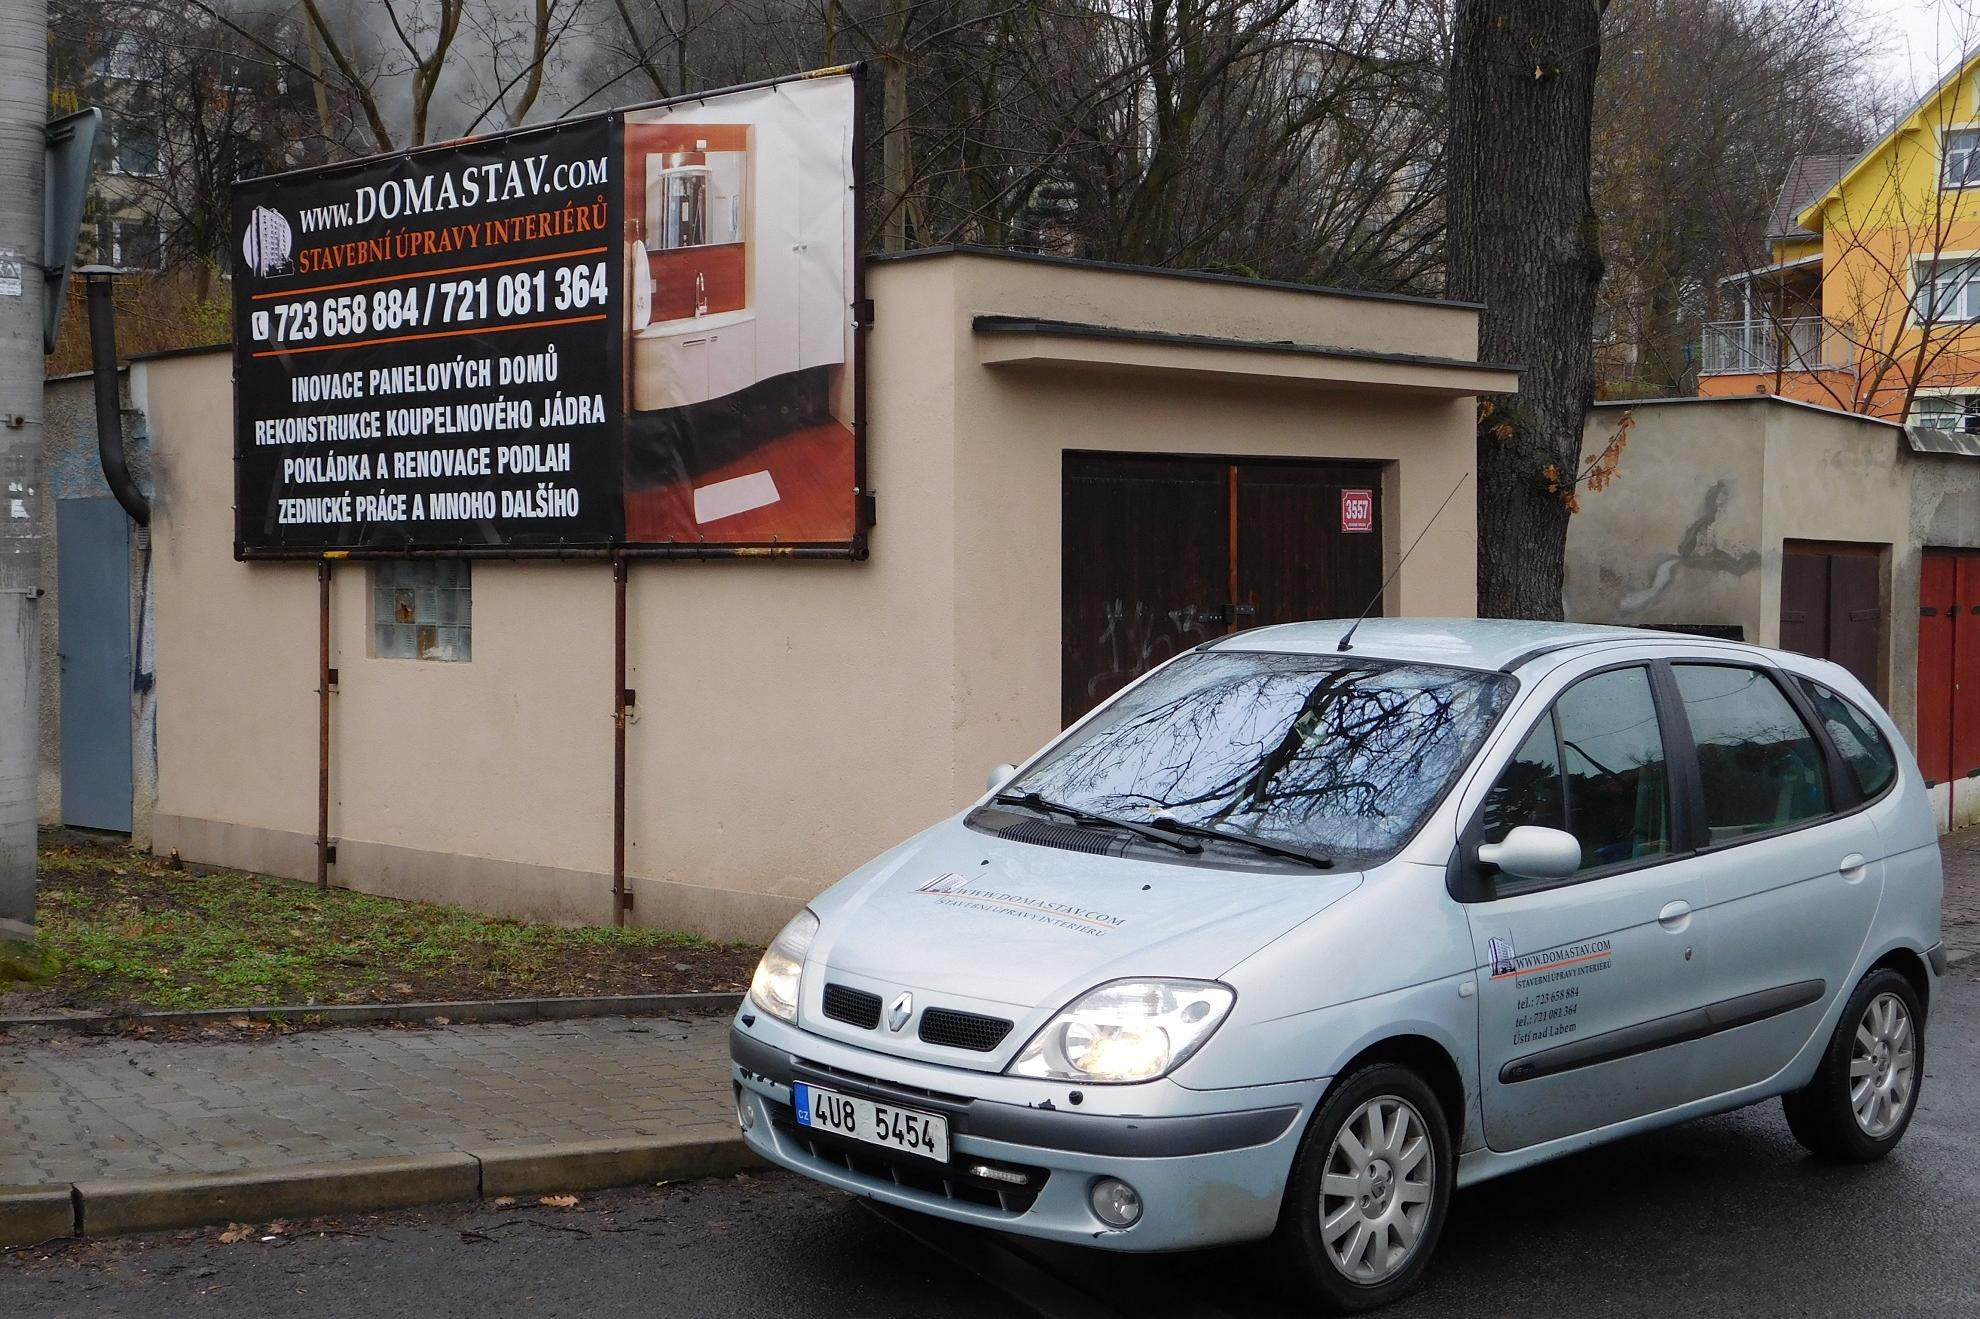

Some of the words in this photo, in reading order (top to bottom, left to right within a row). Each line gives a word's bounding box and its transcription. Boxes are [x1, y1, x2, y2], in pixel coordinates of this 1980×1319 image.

[300, 229, 392, 273] STAVEBNÍ
[396, 222, 481, 259] ÚPRAVY
[485, 195, 608, 247] INTERIÉRŮ
[274, 300, 318, 342] 723
[323, 294, 367, 336] 658
[373, 287, 419, 331] 884
[441, 278, 487, 322] 721
[497, 270, 545, 317] 081
[555, 262, 608, 311] 364
[292, 371, 363, 403] INOVACE
[370, 354, 491, 396] PANELOVÝCH
[500, 343, 558, 385] DOMŮ
[255, 411, 380, 446] REKONSTRUKCE
[387, 395, 532, 437] KOUPELNOVÉHO
[539, 391, 605, 428] JÁDRA
[284, 450, 371, 484] POKLÁDKA
[376, 456, 388, 480] A
[394, 447, 490, 478] RENOVACE
[498, 442, 570, 473] PODLAH
[278, 490, 352, 524] ZEDNICKÉ
[356, 488, 407, 522] PRÁCE
[412, 493, 424, 521] A
[430, 489, 495, 520] MNOHO
[502, 482, 578, 518] DALŠÍHO
[1346, 499, 1368, 519] 3557
[1516, 940, 1611, 970] WWW.DOMASTAV.COM
[1534, 1011, 1547, 1024] 721
[1549, 1007, 1562, 1020] 081
[1563, 1004, 1577, 1016] 364
[1536, 993, 1549, 1006] 723
[1551, 989, 1564, 1002] 658
[1565, 986, 1579, 999] 884
[1513, 1029, 1531, 1046] Ústí
[1532, 1026, 1549, 1041] nad
[1549, 1023, 1577, 1037] Labem
[798, 1109, 809, 1121] CZ
[815, 1094, 856, 1133] 4U8
[875, 1107, 934, 1153] 5454
